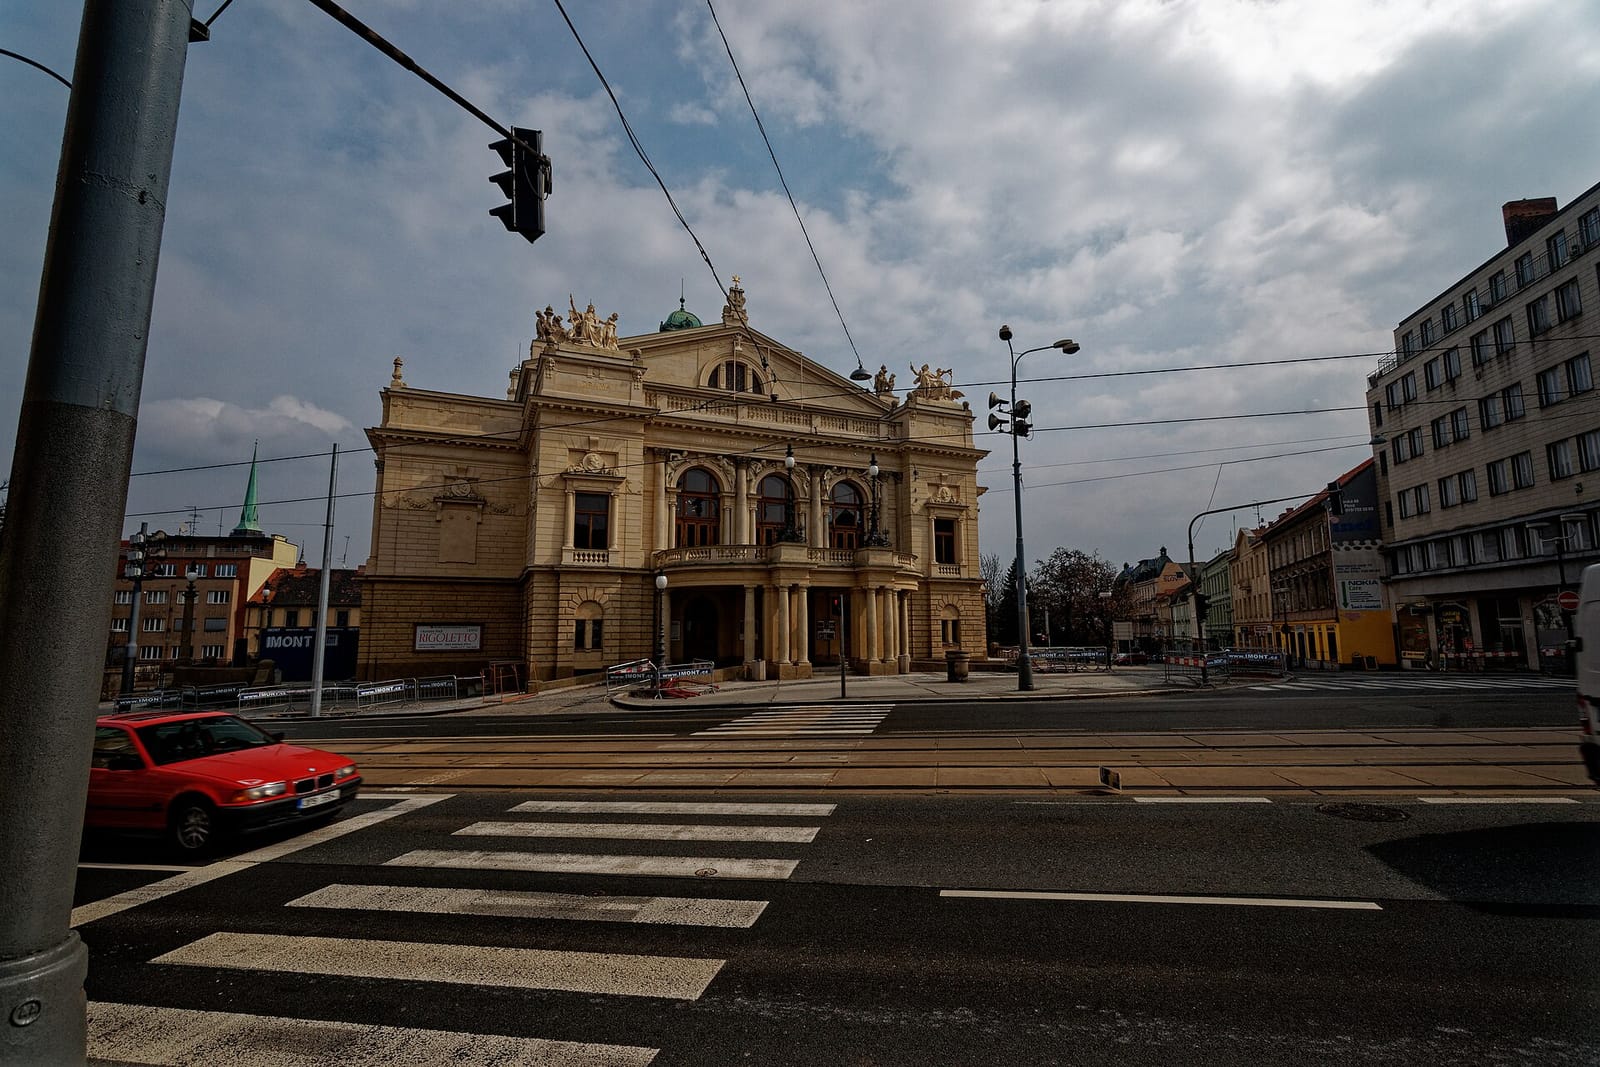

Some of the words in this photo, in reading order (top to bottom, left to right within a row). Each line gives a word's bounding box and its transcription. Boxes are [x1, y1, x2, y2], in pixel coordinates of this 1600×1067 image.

[266, 635, 313, 648] IMONT
[419, 633, 477, 643] RIGOLETTO
[1228, 653, 1279, 661] www.IMONT.cz
[662, 670, 709, 679] www.IMONT.cz
